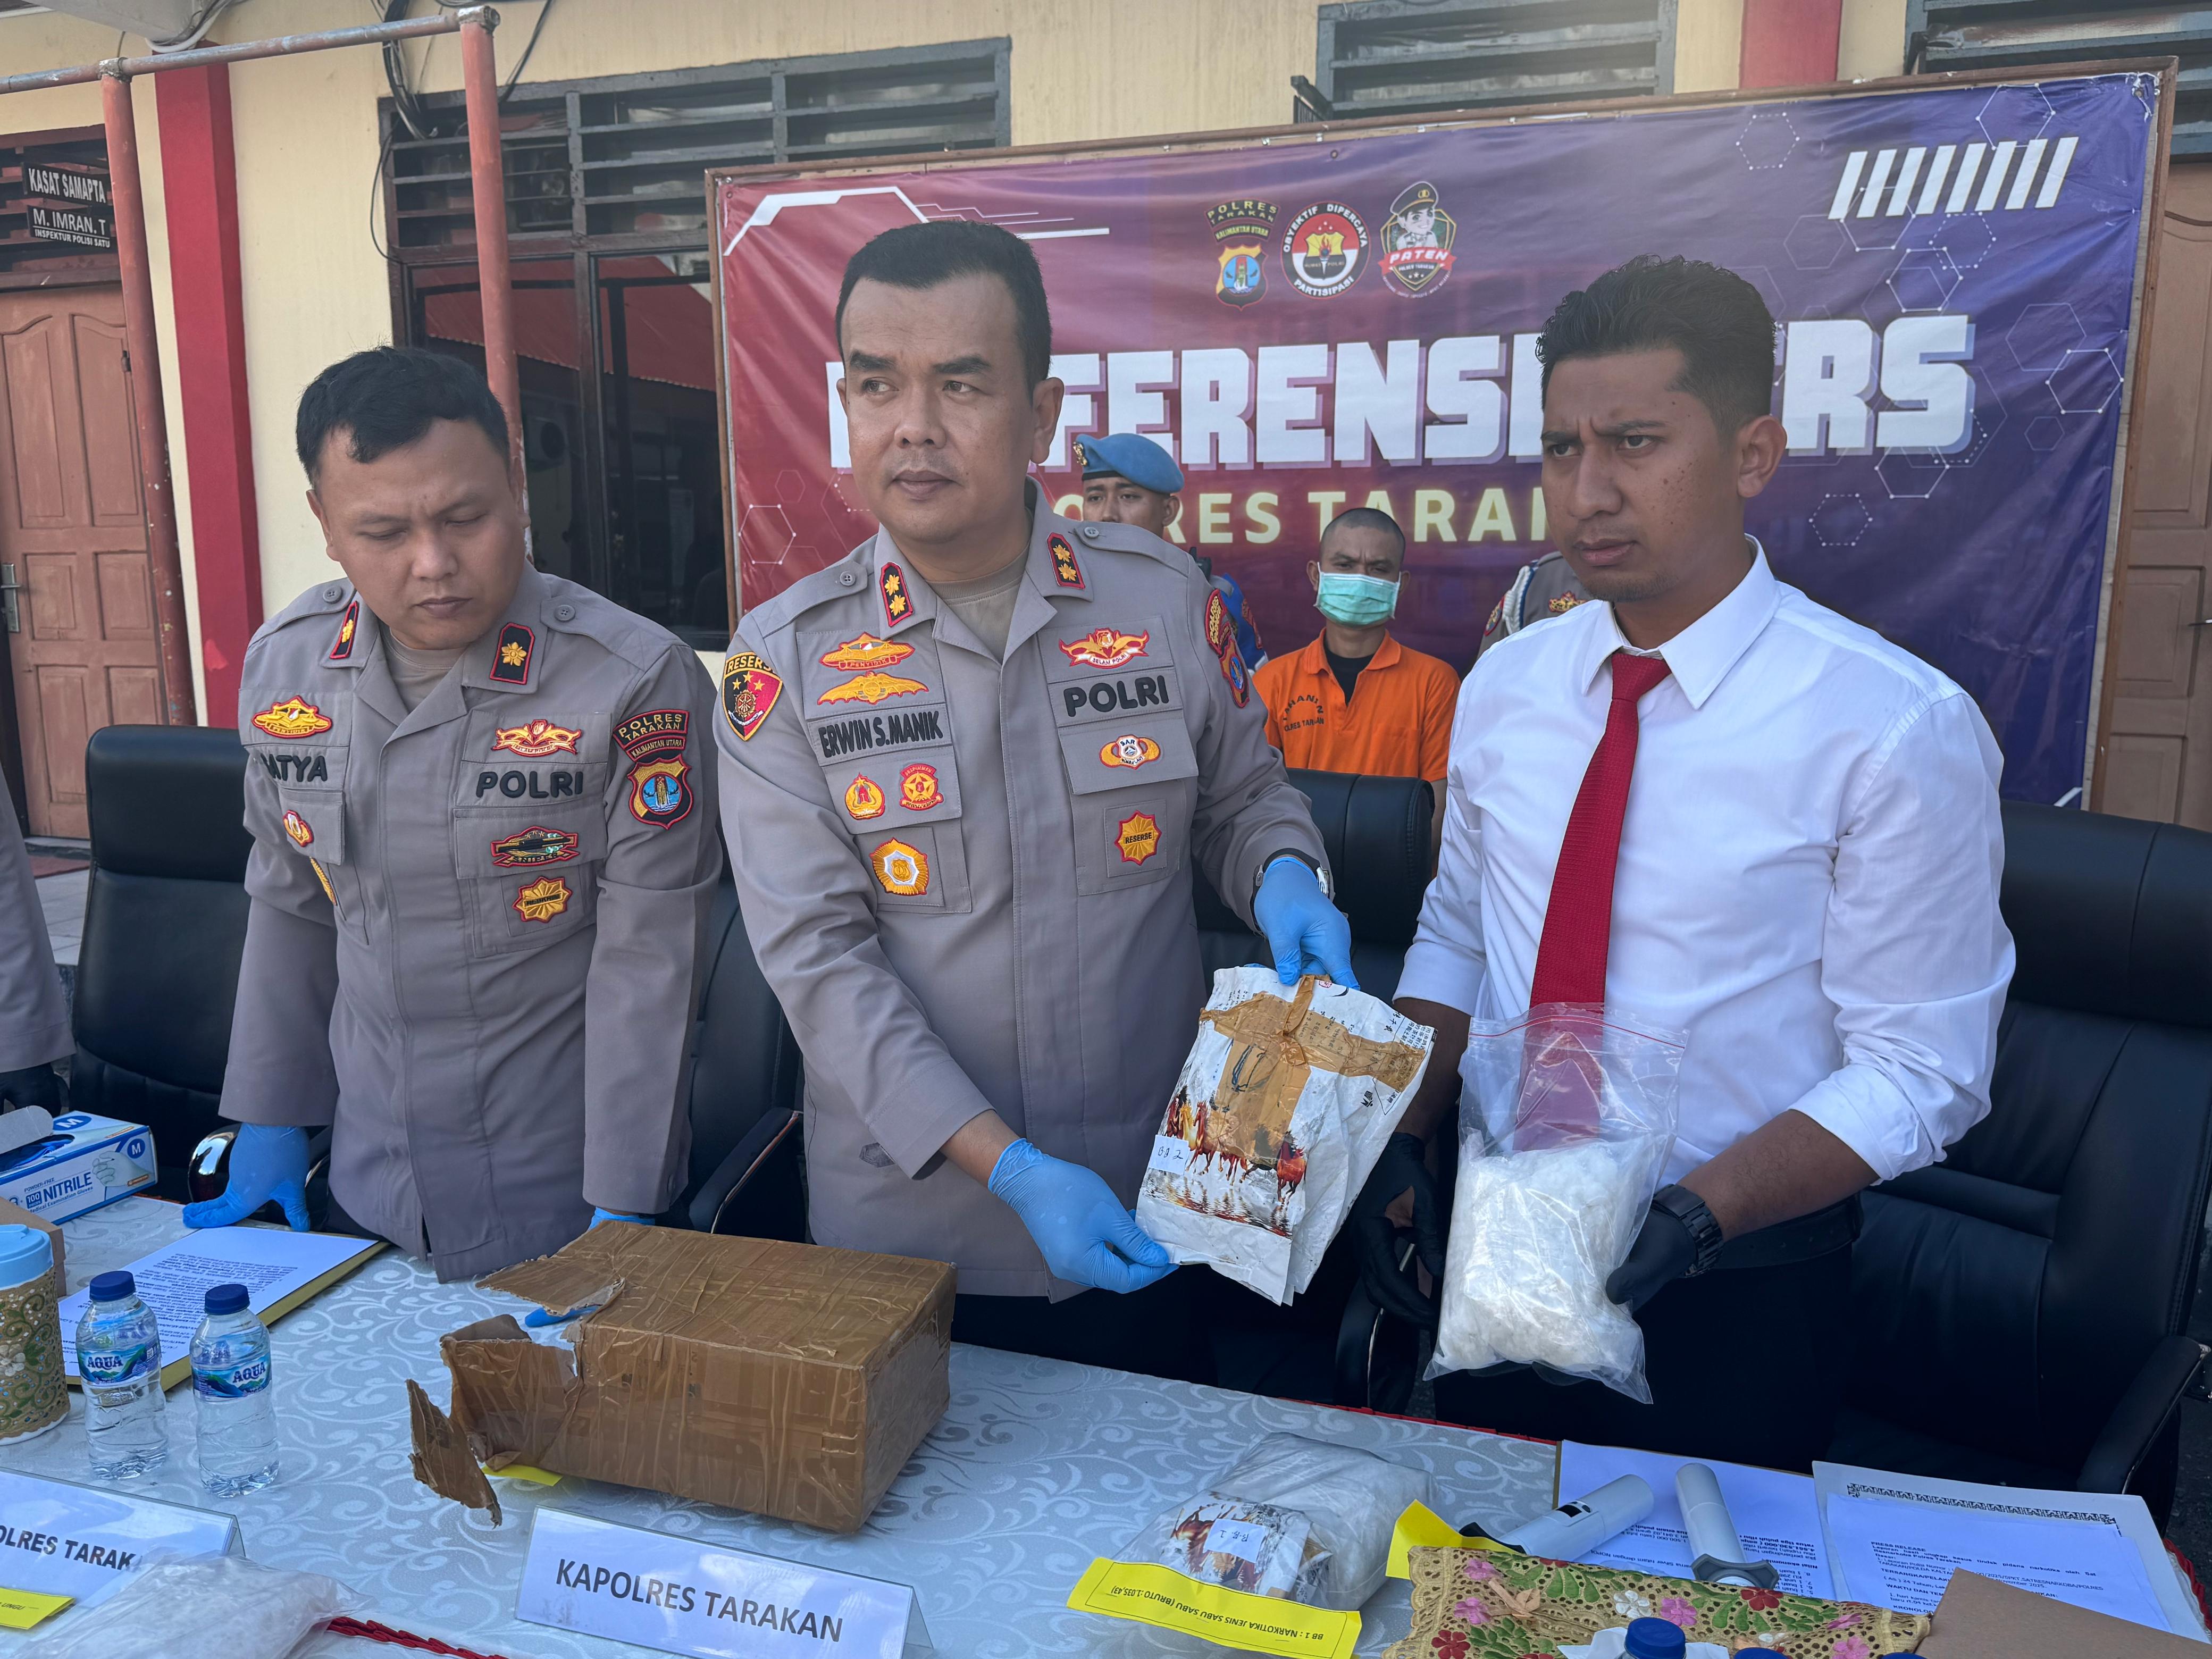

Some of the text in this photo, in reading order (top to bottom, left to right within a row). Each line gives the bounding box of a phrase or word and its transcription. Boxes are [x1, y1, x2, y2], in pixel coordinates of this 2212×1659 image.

[29, 168, 106, 203] KASAT SAMAPTA
[1207, 201, 1277, 219] POLRES
[1211, 211, 1273, 224] TARAKAN
[33, 208, 49, 226] M.
[98, 219, 106, 235] T
[1283, 204, 1368, 253] OBYEKTIF DIPERCAYA
[35, 229, 110, 248] INSPEKTUR POLISI SATU
[1216, 225, 1250, 240] KALIMANTAN
[1390, 249, 1448, 264] PATEN
[1294, 276, 1354, 296] PARTISIPASI
[1063, 675, 1169, 717] POLRI
[618, 714, 682, 737] POLRES
[625, 723, 680, 741] TARAKAN
[818, 711, 943, 758] ERWIN S.MANIK
[631, 740, 664, 757] KALIMANTAN
[476, 770, 583, 798] POLRI
[1125, 832, 1152, 844] RESERSE
[56, 1118, 83, 1128] M
[132, 1143, 141, 1155] M
[1172, 1150, 1183, 1159] 2
[24, 1177, 55, 1192] POWDER-FREE
[27, 1194, 39, 1202] 100
[44, 1171, 92, 1202] NITRILE
[88, 1356, 123, 1370] AQUA
[233, 1362, 265, 1382] AQUA
[64, 1539, 139, 1570] TARAK
[556, 1559, 842, 1642] KAPOLRES TARAKAN
[1144, 1590, 1175, 1606] (BRUTO
[1176, 1602, 1200, 1615] SABU
[1200, 1611, 1224, 1622] SABU
[1225, 1617, 1247, 1627] JENIS
[1250, 1622, 1298, 1637] NARKOTIKA
